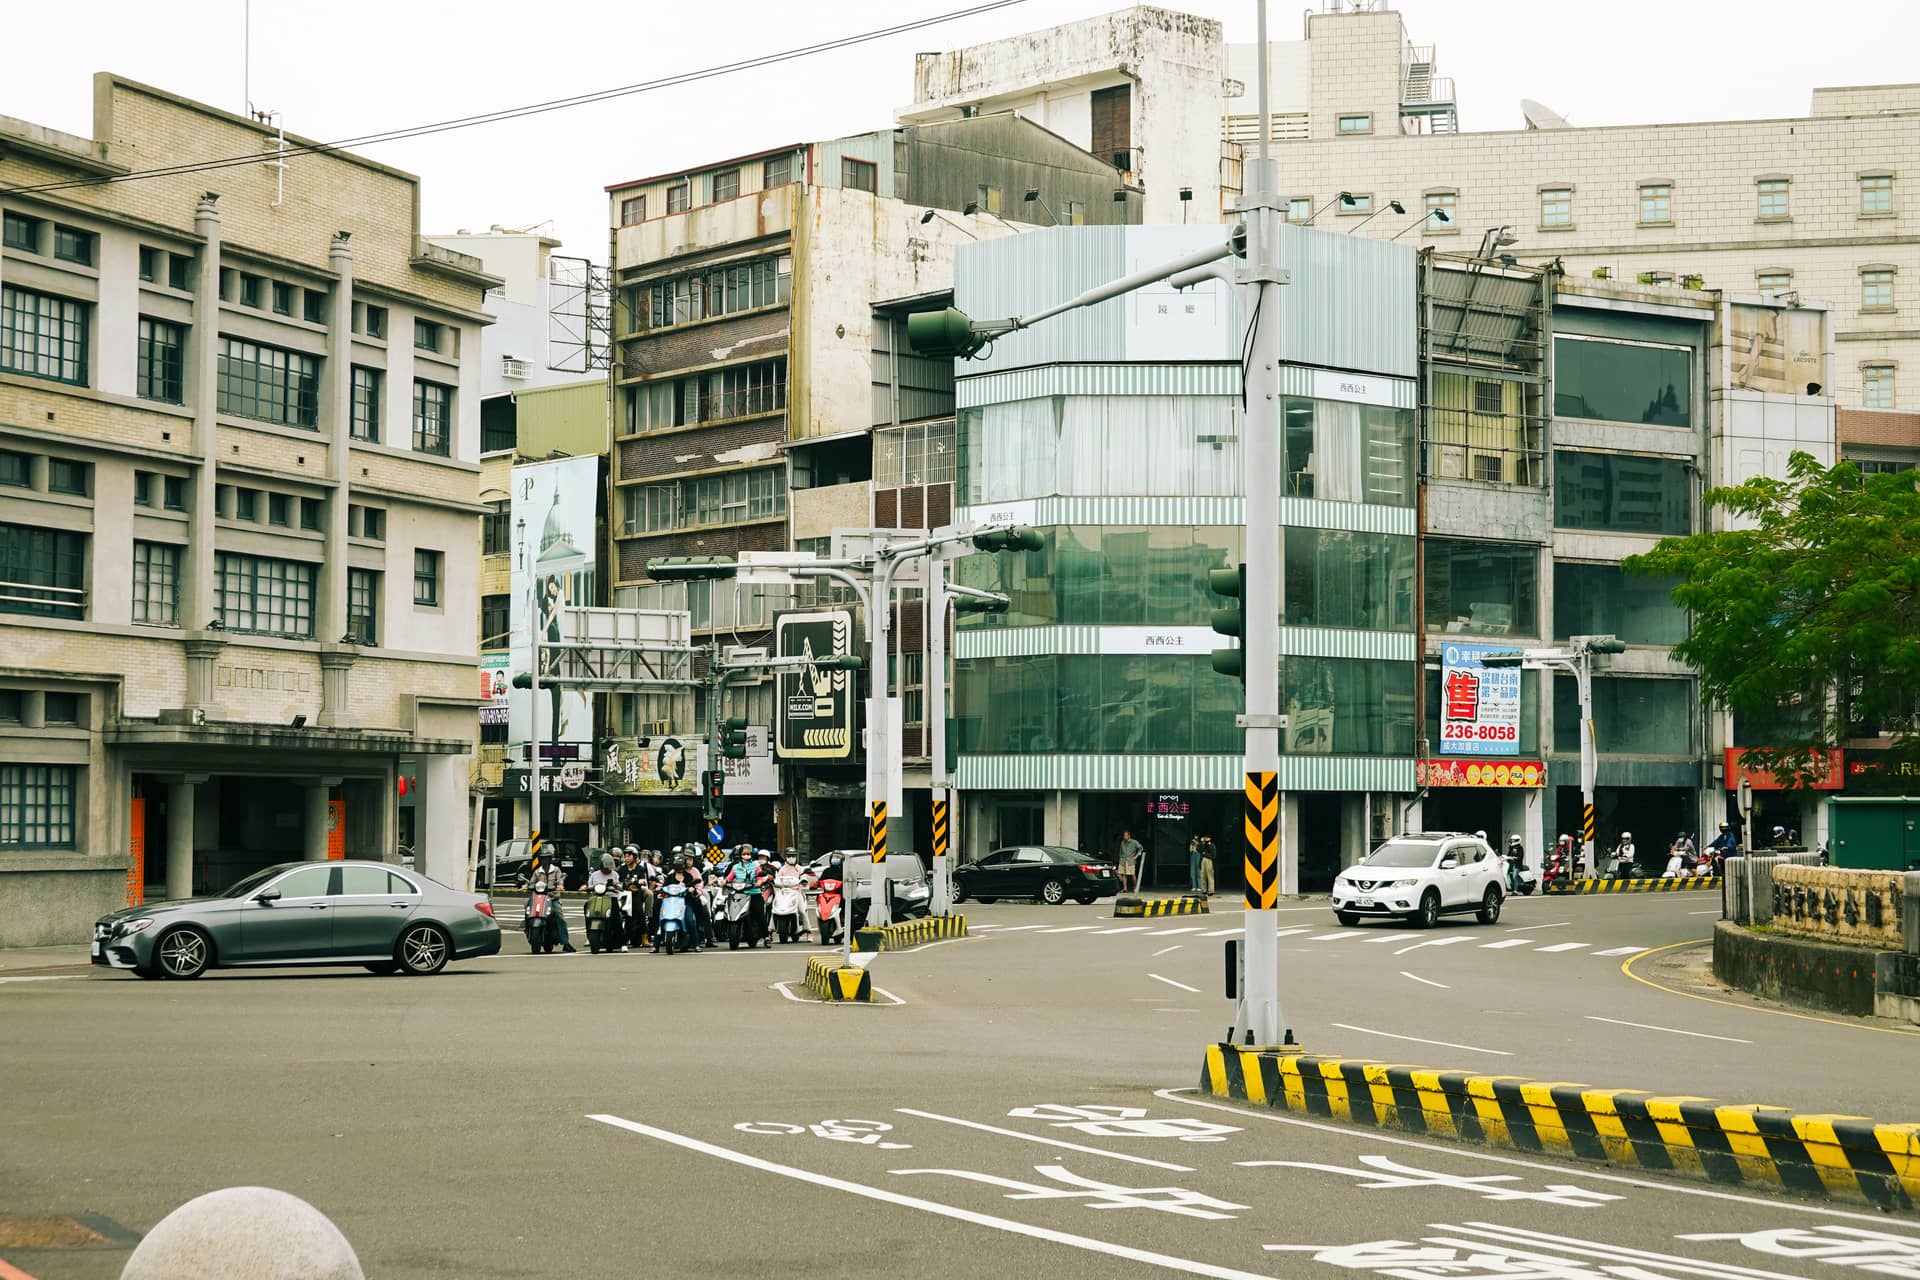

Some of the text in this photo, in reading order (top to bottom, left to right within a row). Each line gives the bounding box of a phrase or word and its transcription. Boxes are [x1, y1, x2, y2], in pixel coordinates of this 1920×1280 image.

[1340, 383, 1367, 394] 西西公主
[991, 511, 1015, 522] 西西公主
[1145, 635, 1184, 646] 西西公主
[1446, 671, 1478, 721] 售
[1481, 686, 1518, 699] 第一品牌
[1445, 725, 1516, 740] 236-8058
